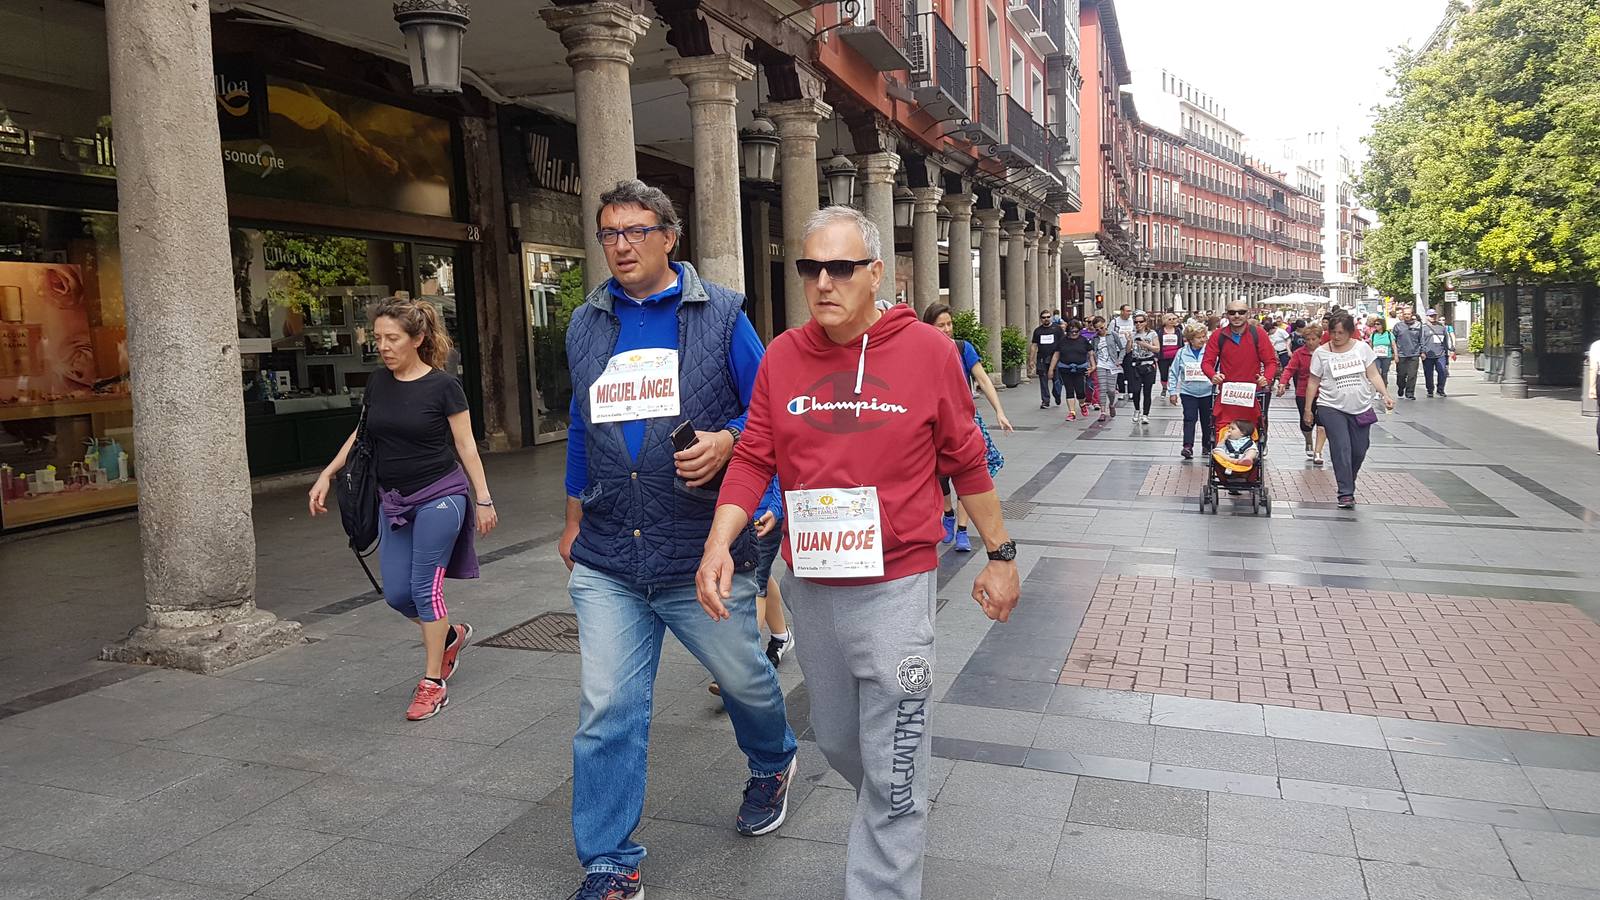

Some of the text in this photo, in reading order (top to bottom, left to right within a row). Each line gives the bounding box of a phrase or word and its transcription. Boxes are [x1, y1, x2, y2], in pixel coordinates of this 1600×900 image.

[224, 148, 285, 171] sonotone
[467, 225, 480, 241] 28
[596, 375, 675, 404] MIGUEL ÁNGEL
[787, 395, 908, 418] Champion
[796, 524, 875, 554] JUAN JOSÉ
